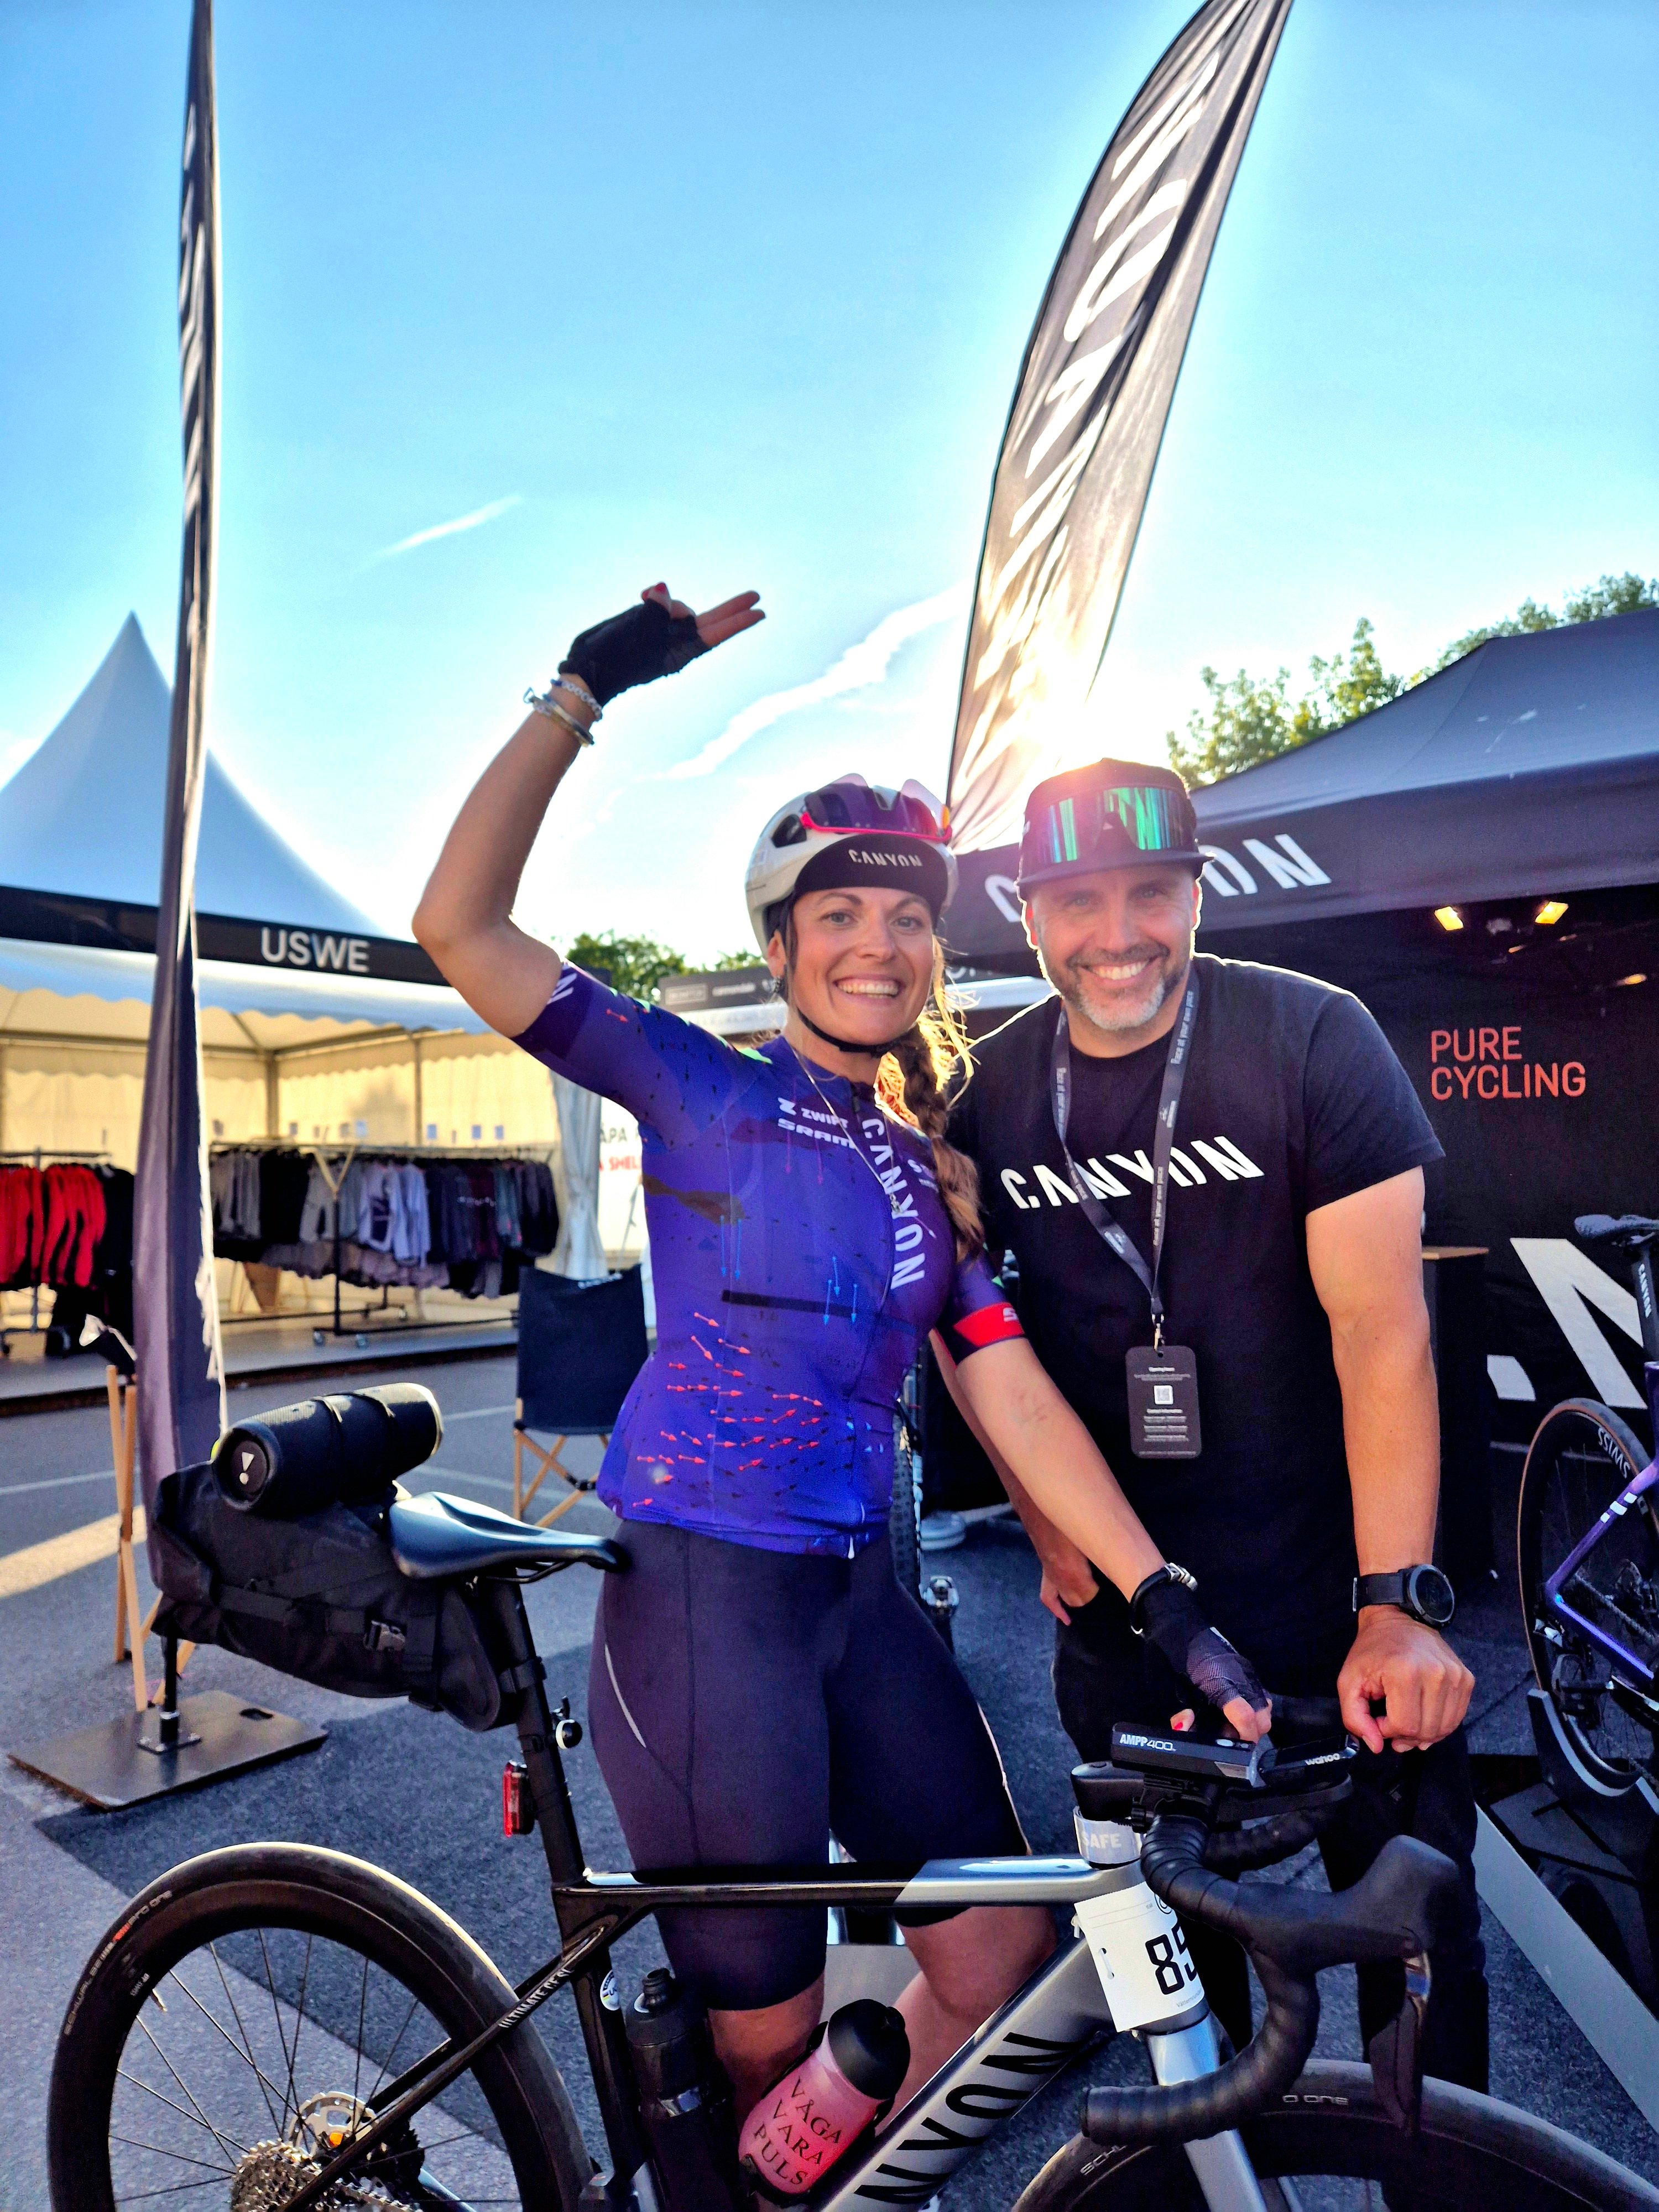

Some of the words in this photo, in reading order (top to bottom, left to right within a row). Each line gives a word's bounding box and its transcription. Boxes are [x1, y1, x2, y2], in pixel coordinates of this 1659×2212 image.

[848, 849, 922, 867] CANYON
[261, 926, 370, 973] USWE
[1431, 1026, 1522, 1063] PURE
[1431, 1062, 1586, 1100] CYCLING
[778, 1118, 857, 1149] SRAM
[801, 1108, 848, 1128] ZWIFT
[1000, 1136, 1265, 1209] CANYON
[862, 1118, 926, 1290] CANYON
[1598, 1427, 1631, 1479] SWISS
[1305, 1752, 1340, 1766] wahoo
[498, 1988, 548, 2028] ULTIMATE
[791, 2075, 842, 2143] VÅGA
[773, 2099, 823, 2164] VARA
[753, 2124, 808, 2184] PULS
